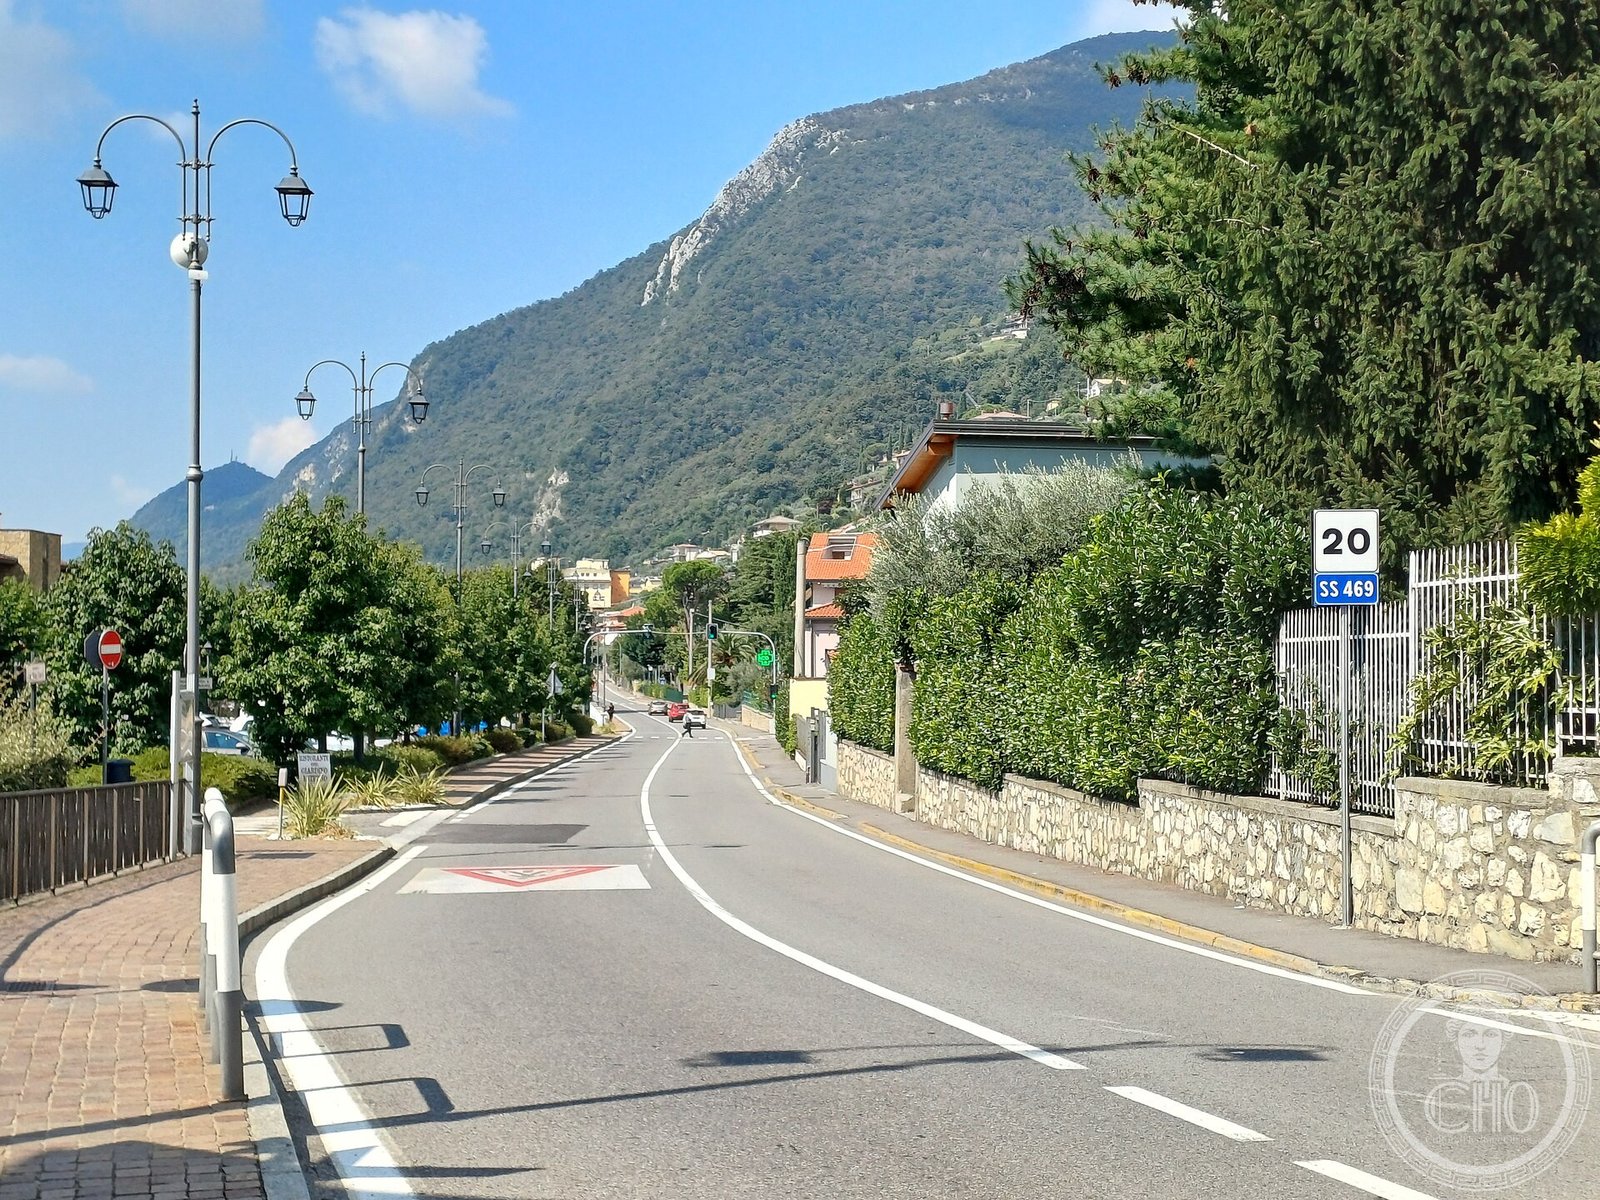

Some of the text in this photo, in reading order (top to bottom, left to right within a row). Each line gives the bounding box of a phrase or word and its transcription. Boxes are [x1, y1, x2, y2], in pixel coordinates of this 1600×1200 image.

[1322, 527, 1371, 555] 20
[1319, 580, 1374, 598] SS 469
